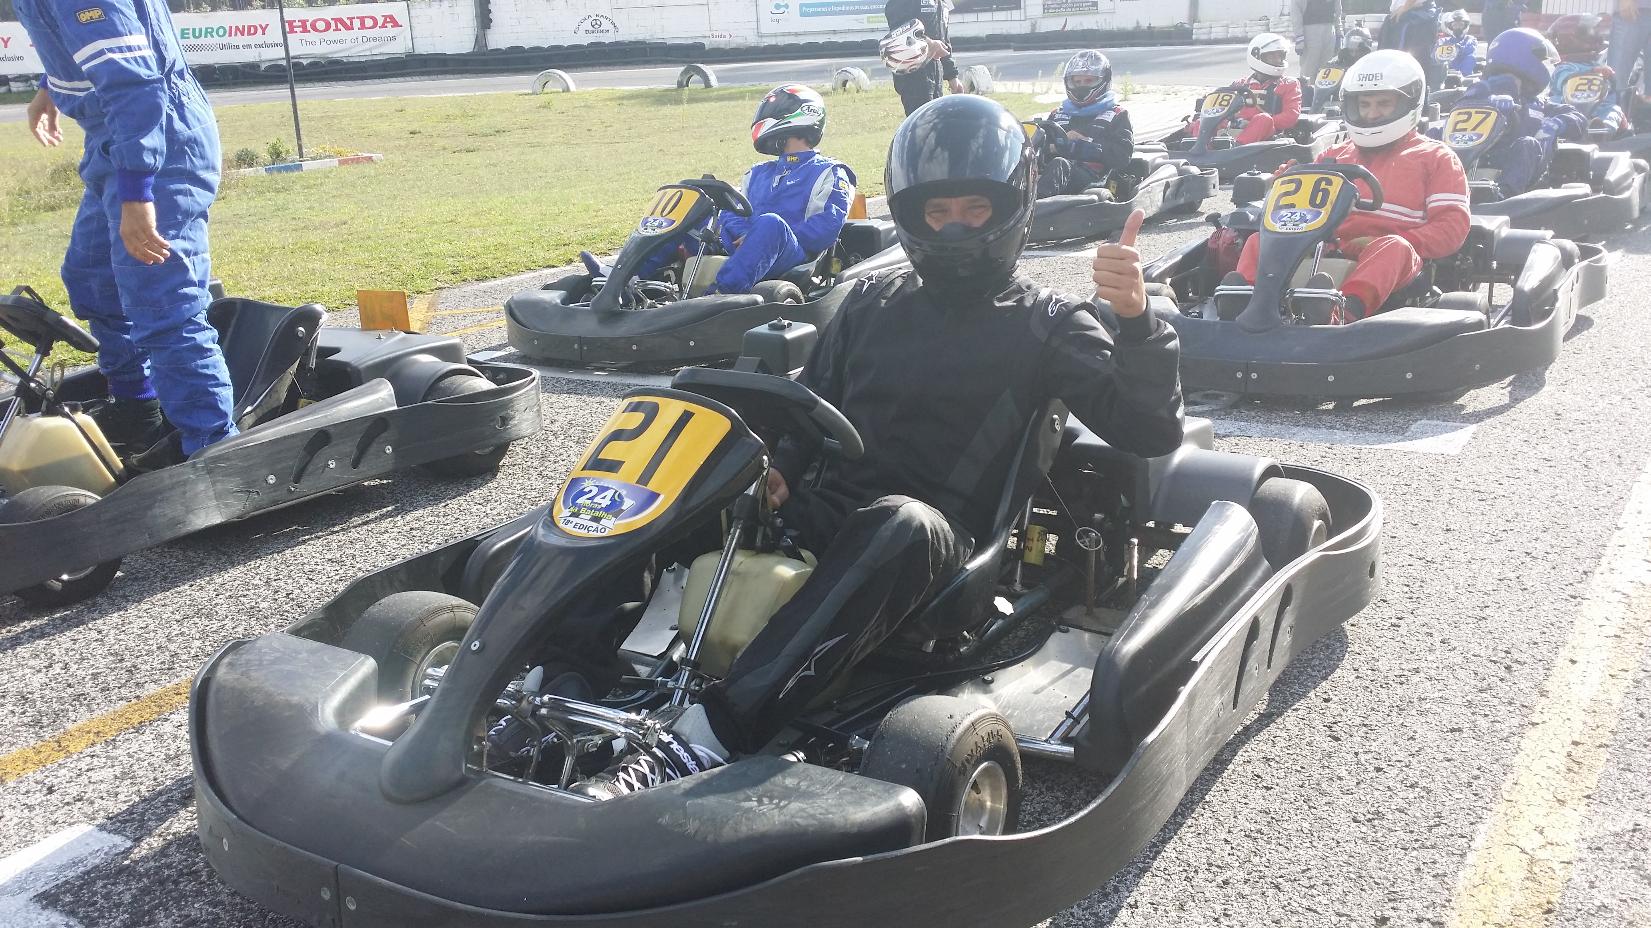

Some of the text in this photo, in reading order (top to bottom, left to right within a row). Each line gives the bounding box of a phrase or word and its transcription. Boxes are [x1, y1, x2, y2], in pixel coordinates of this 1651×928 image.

[180, 23, 269, 39] EUROINDY
[285, 14, 404, 34] HONDA
[218, 42, 240, 51] Utiliza
[254, 40, 284, 49] exclusivo
[298, 34, 397, 47] The Power of Dreams
[1322, 68, 1331, 79] 9
[1356, 72, 1384, 82] SHOEI
[1212, 94, 1233, 107] 18
[1452, 111, 1493, 133] 27
[1273, 176, 1333, 209] 26
[649, 189, 684, 218] 10
[580, 400, 696, 487] 21
[575, 485, 615, 508] 24
